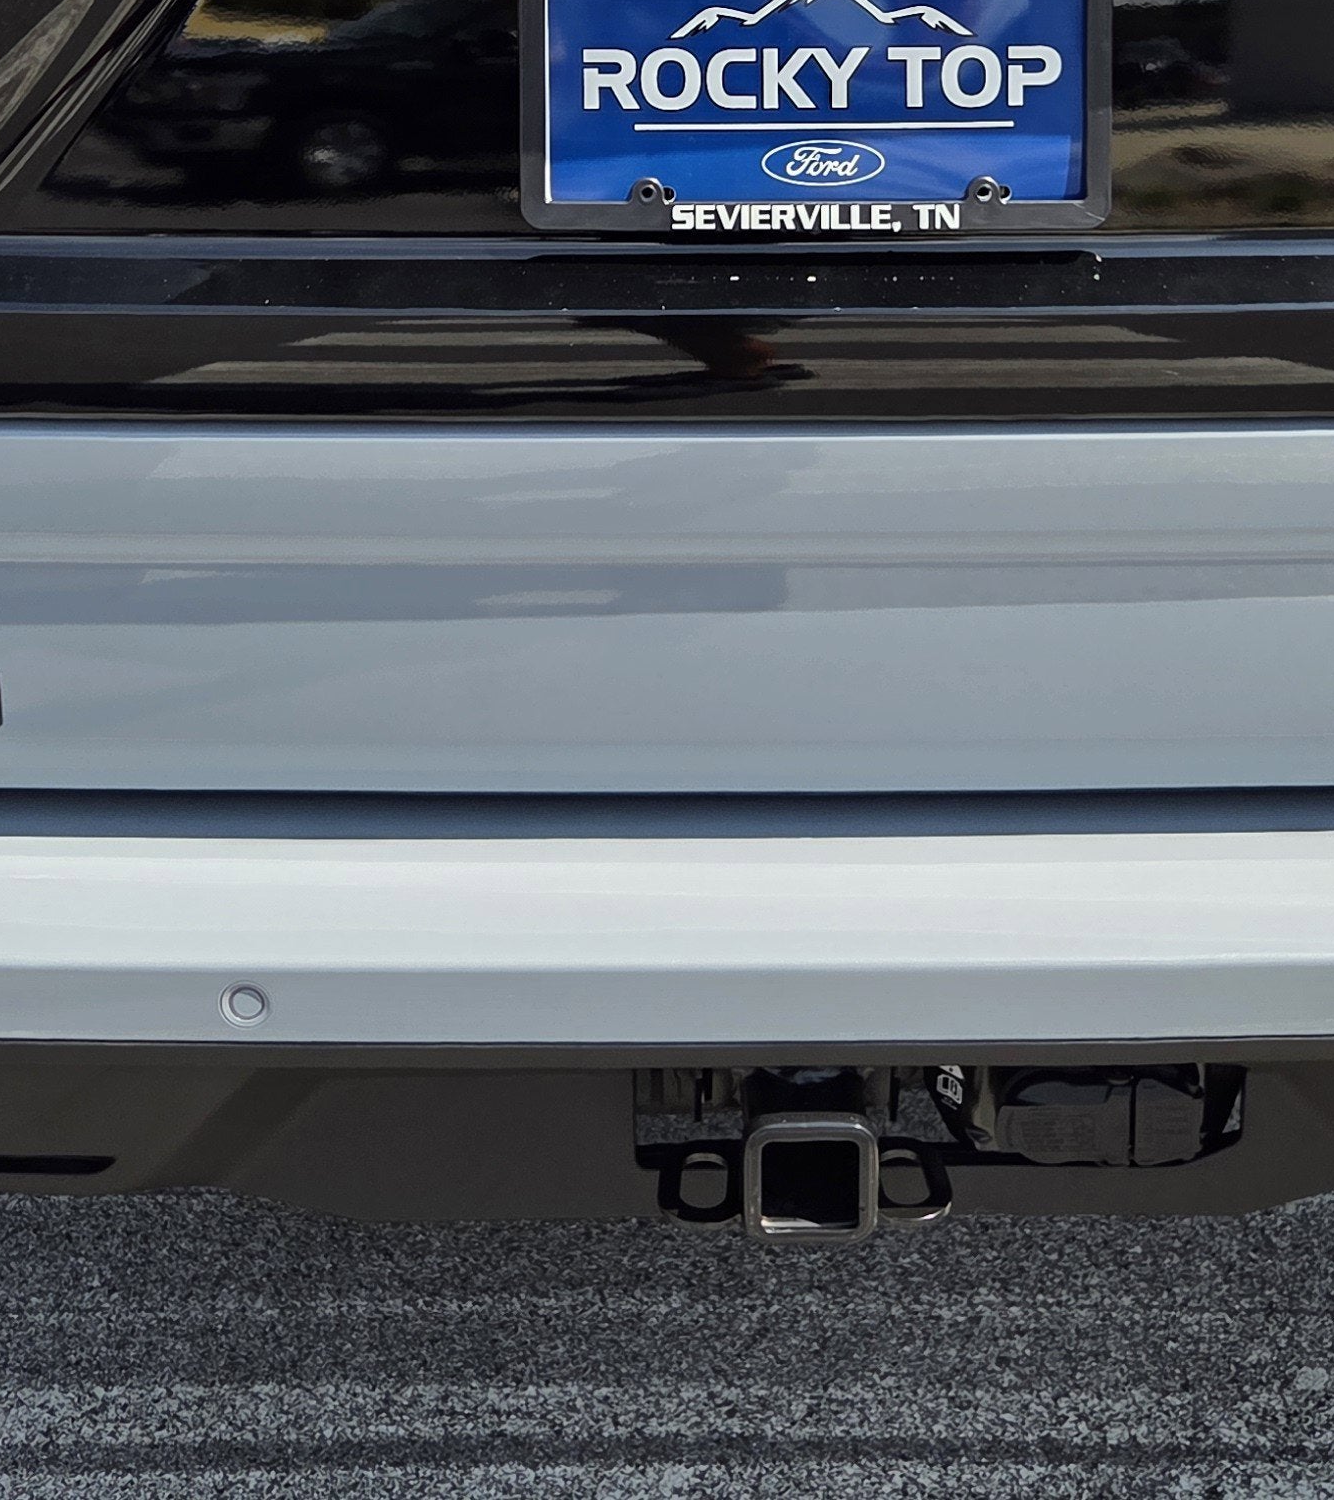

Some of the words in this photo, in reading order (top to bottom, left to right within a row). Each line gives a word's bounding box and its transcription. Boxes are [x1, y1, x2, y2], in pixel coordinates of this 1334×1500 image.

[582, 47, 871, 111] ROCKY
[887, 45, 1063, 108] TOP
[785, 147, 860, 179] Ford
[671, 203, 902, 233] SEVIERVILLE,
[914, 203, 961, 230] TN
